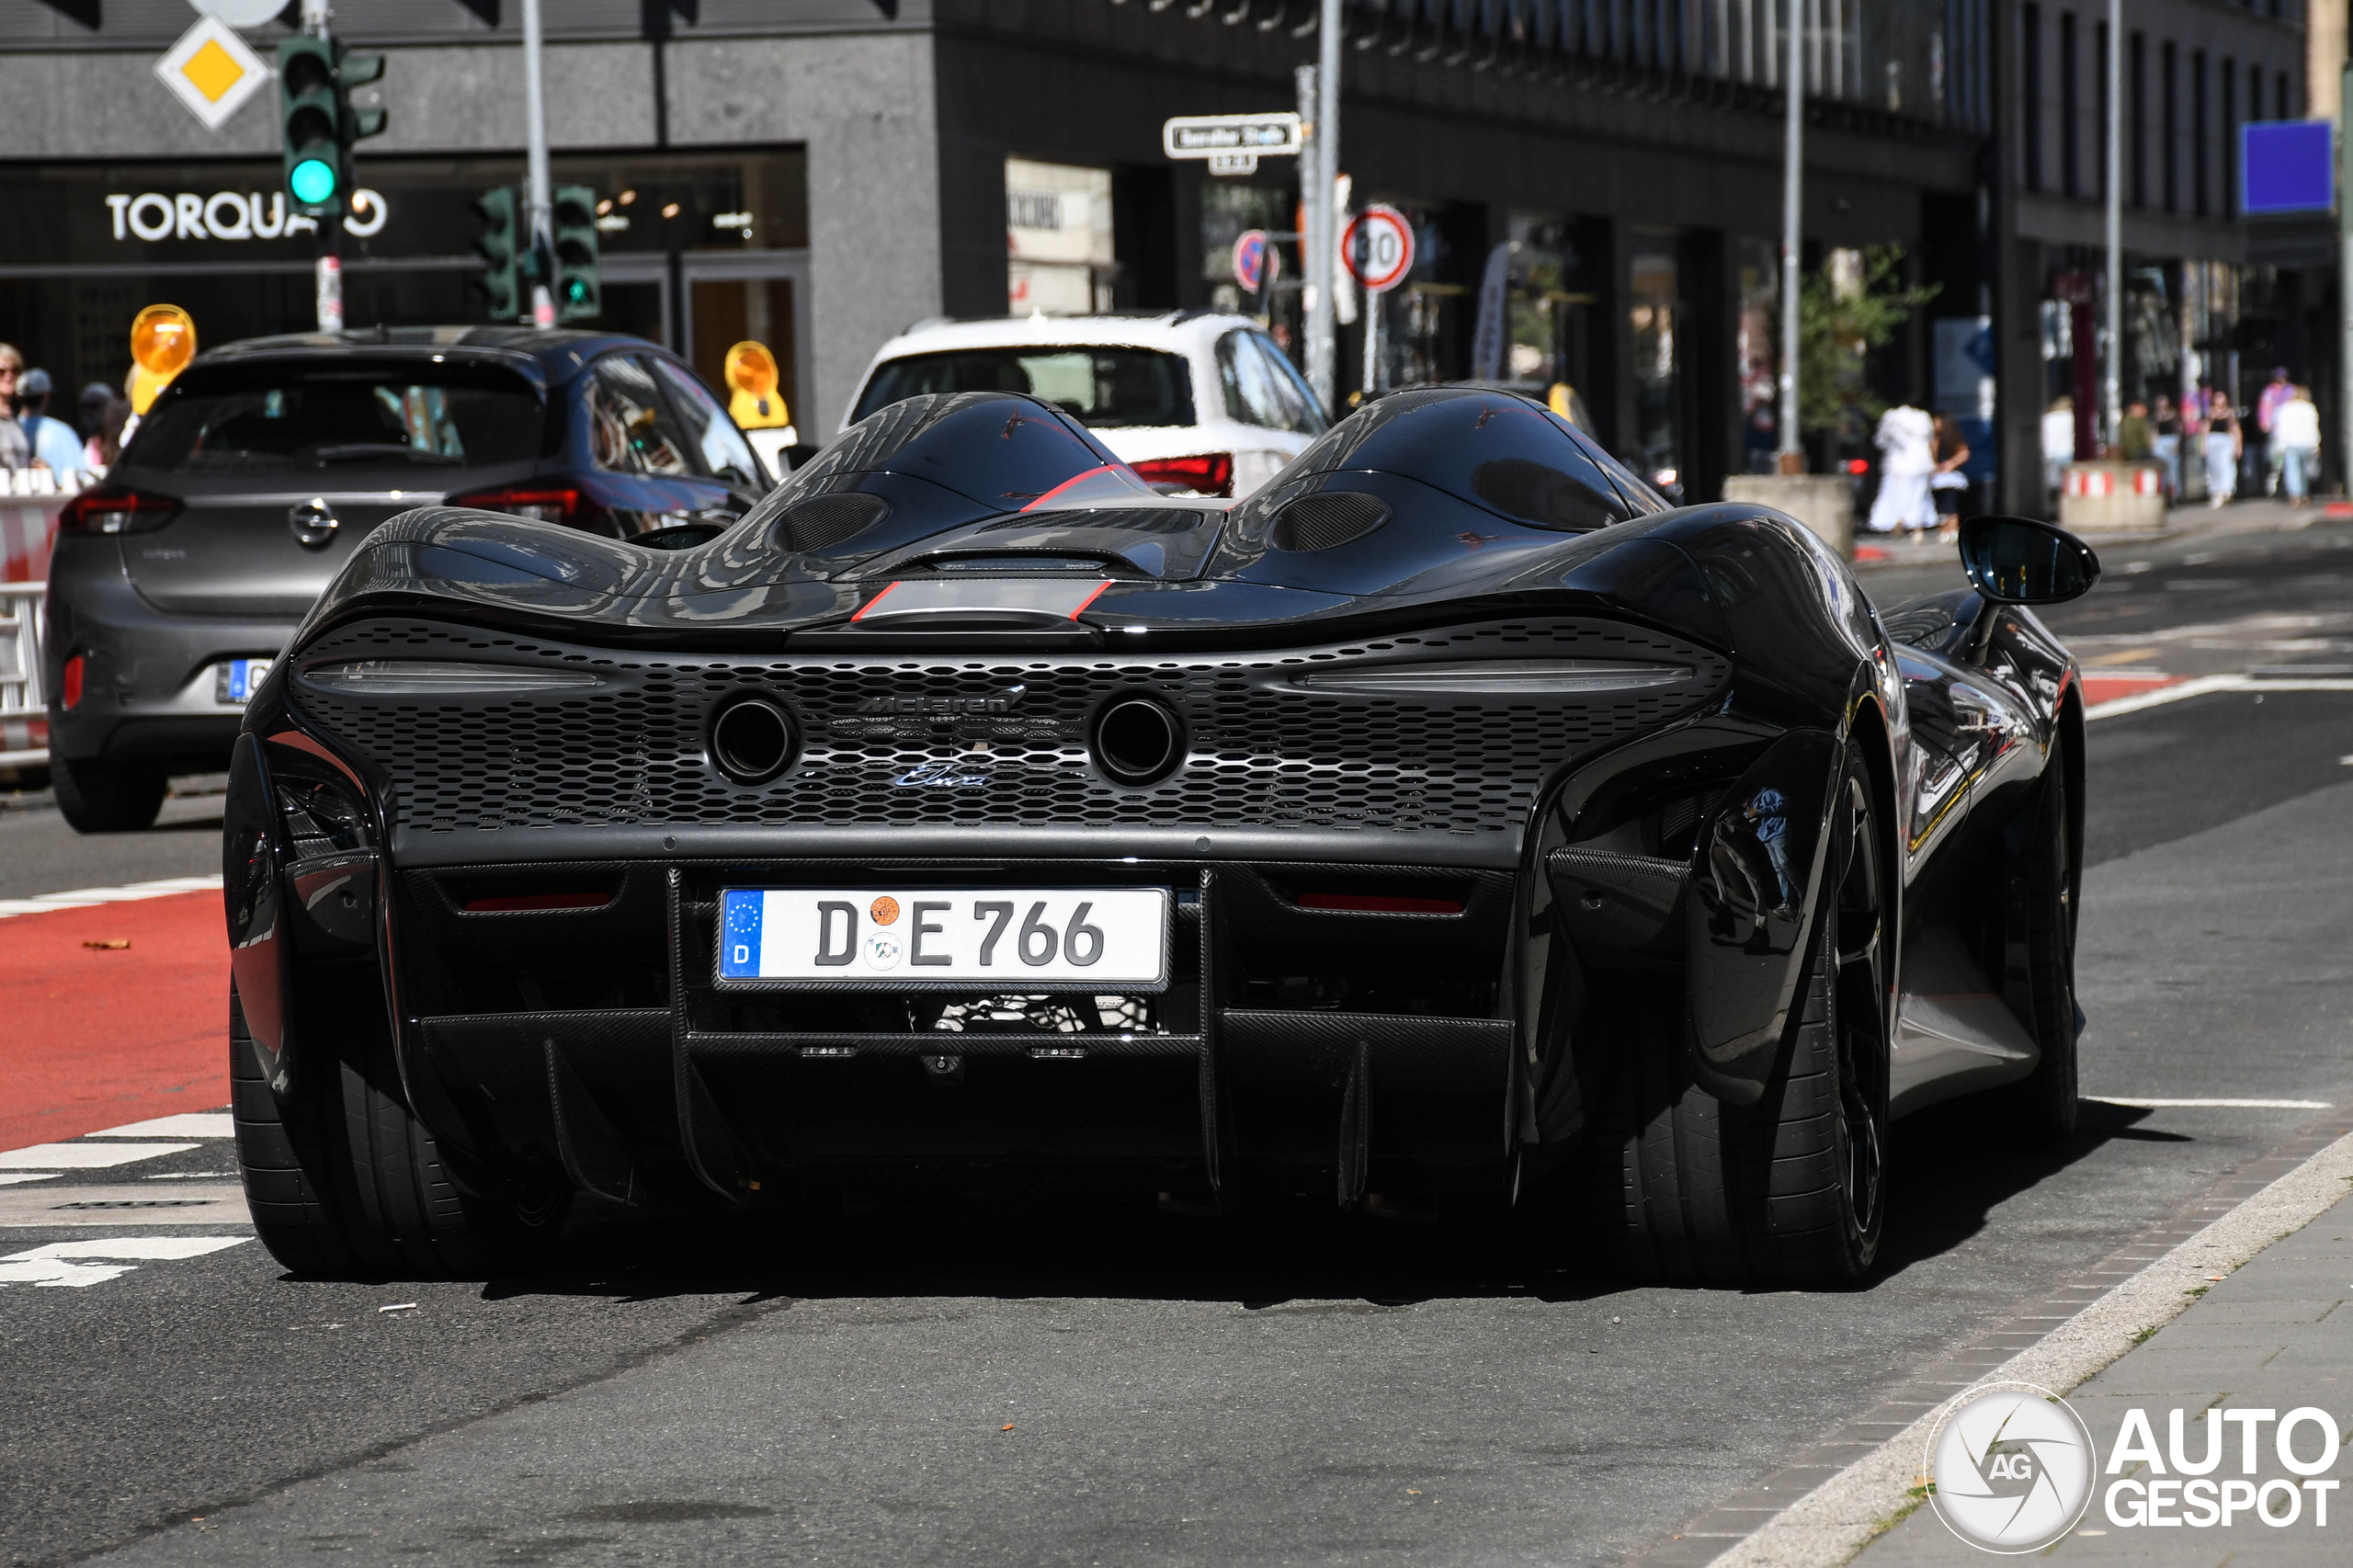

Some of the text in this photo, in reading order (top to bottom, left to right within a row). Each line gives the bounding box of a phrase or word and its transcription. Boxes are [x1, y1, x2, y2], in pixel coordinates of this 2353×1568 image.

[1357, 230, 1396, 267] 30
[858, 697, 1009, 713] McLaren
[814, 900, 859, 966] D
[910, 900, 952, 966] E
[973, 900, 1105, 966] 766
[733, 944, 749, 964] D
